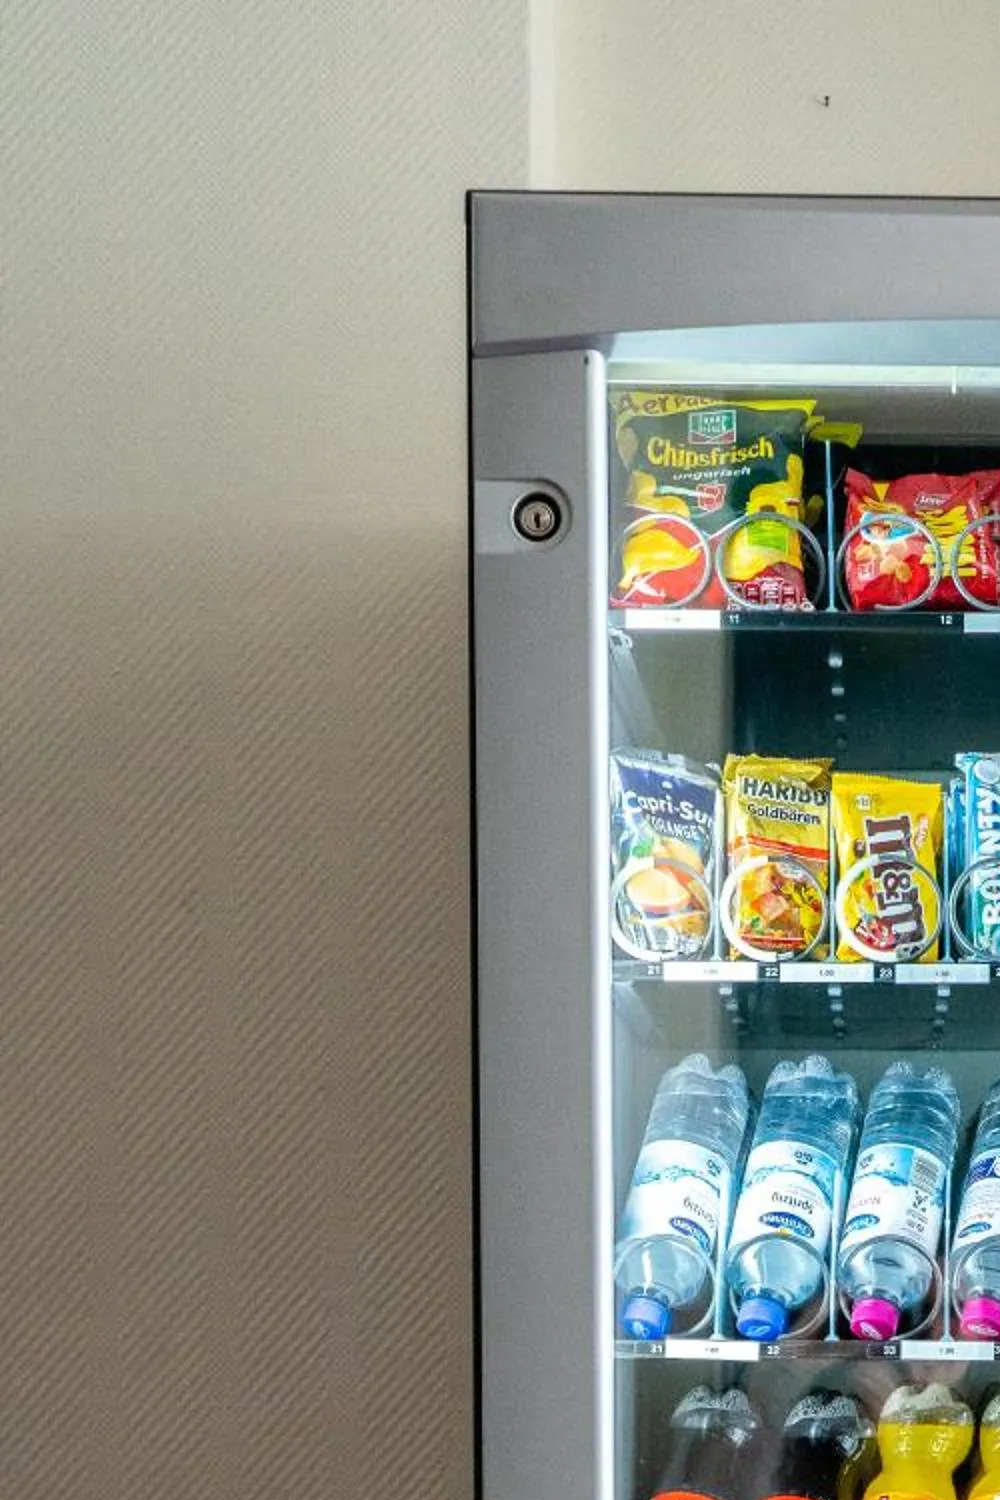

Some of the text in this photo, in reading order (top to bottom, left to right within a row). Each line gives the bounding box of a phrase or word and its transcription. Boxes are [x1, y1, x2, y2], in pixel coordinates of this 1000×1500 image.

[647, 436, 774, 470] Chipsfrisch
[729, 614, 740, 624] 11
[940, 616, 953, 625] 12
[747, 803, 821, 825] Goldbären
[647, 966, 661, 976] 21
[765, 967, 779, 977] 22
[879, 968, 893, 978] 23
